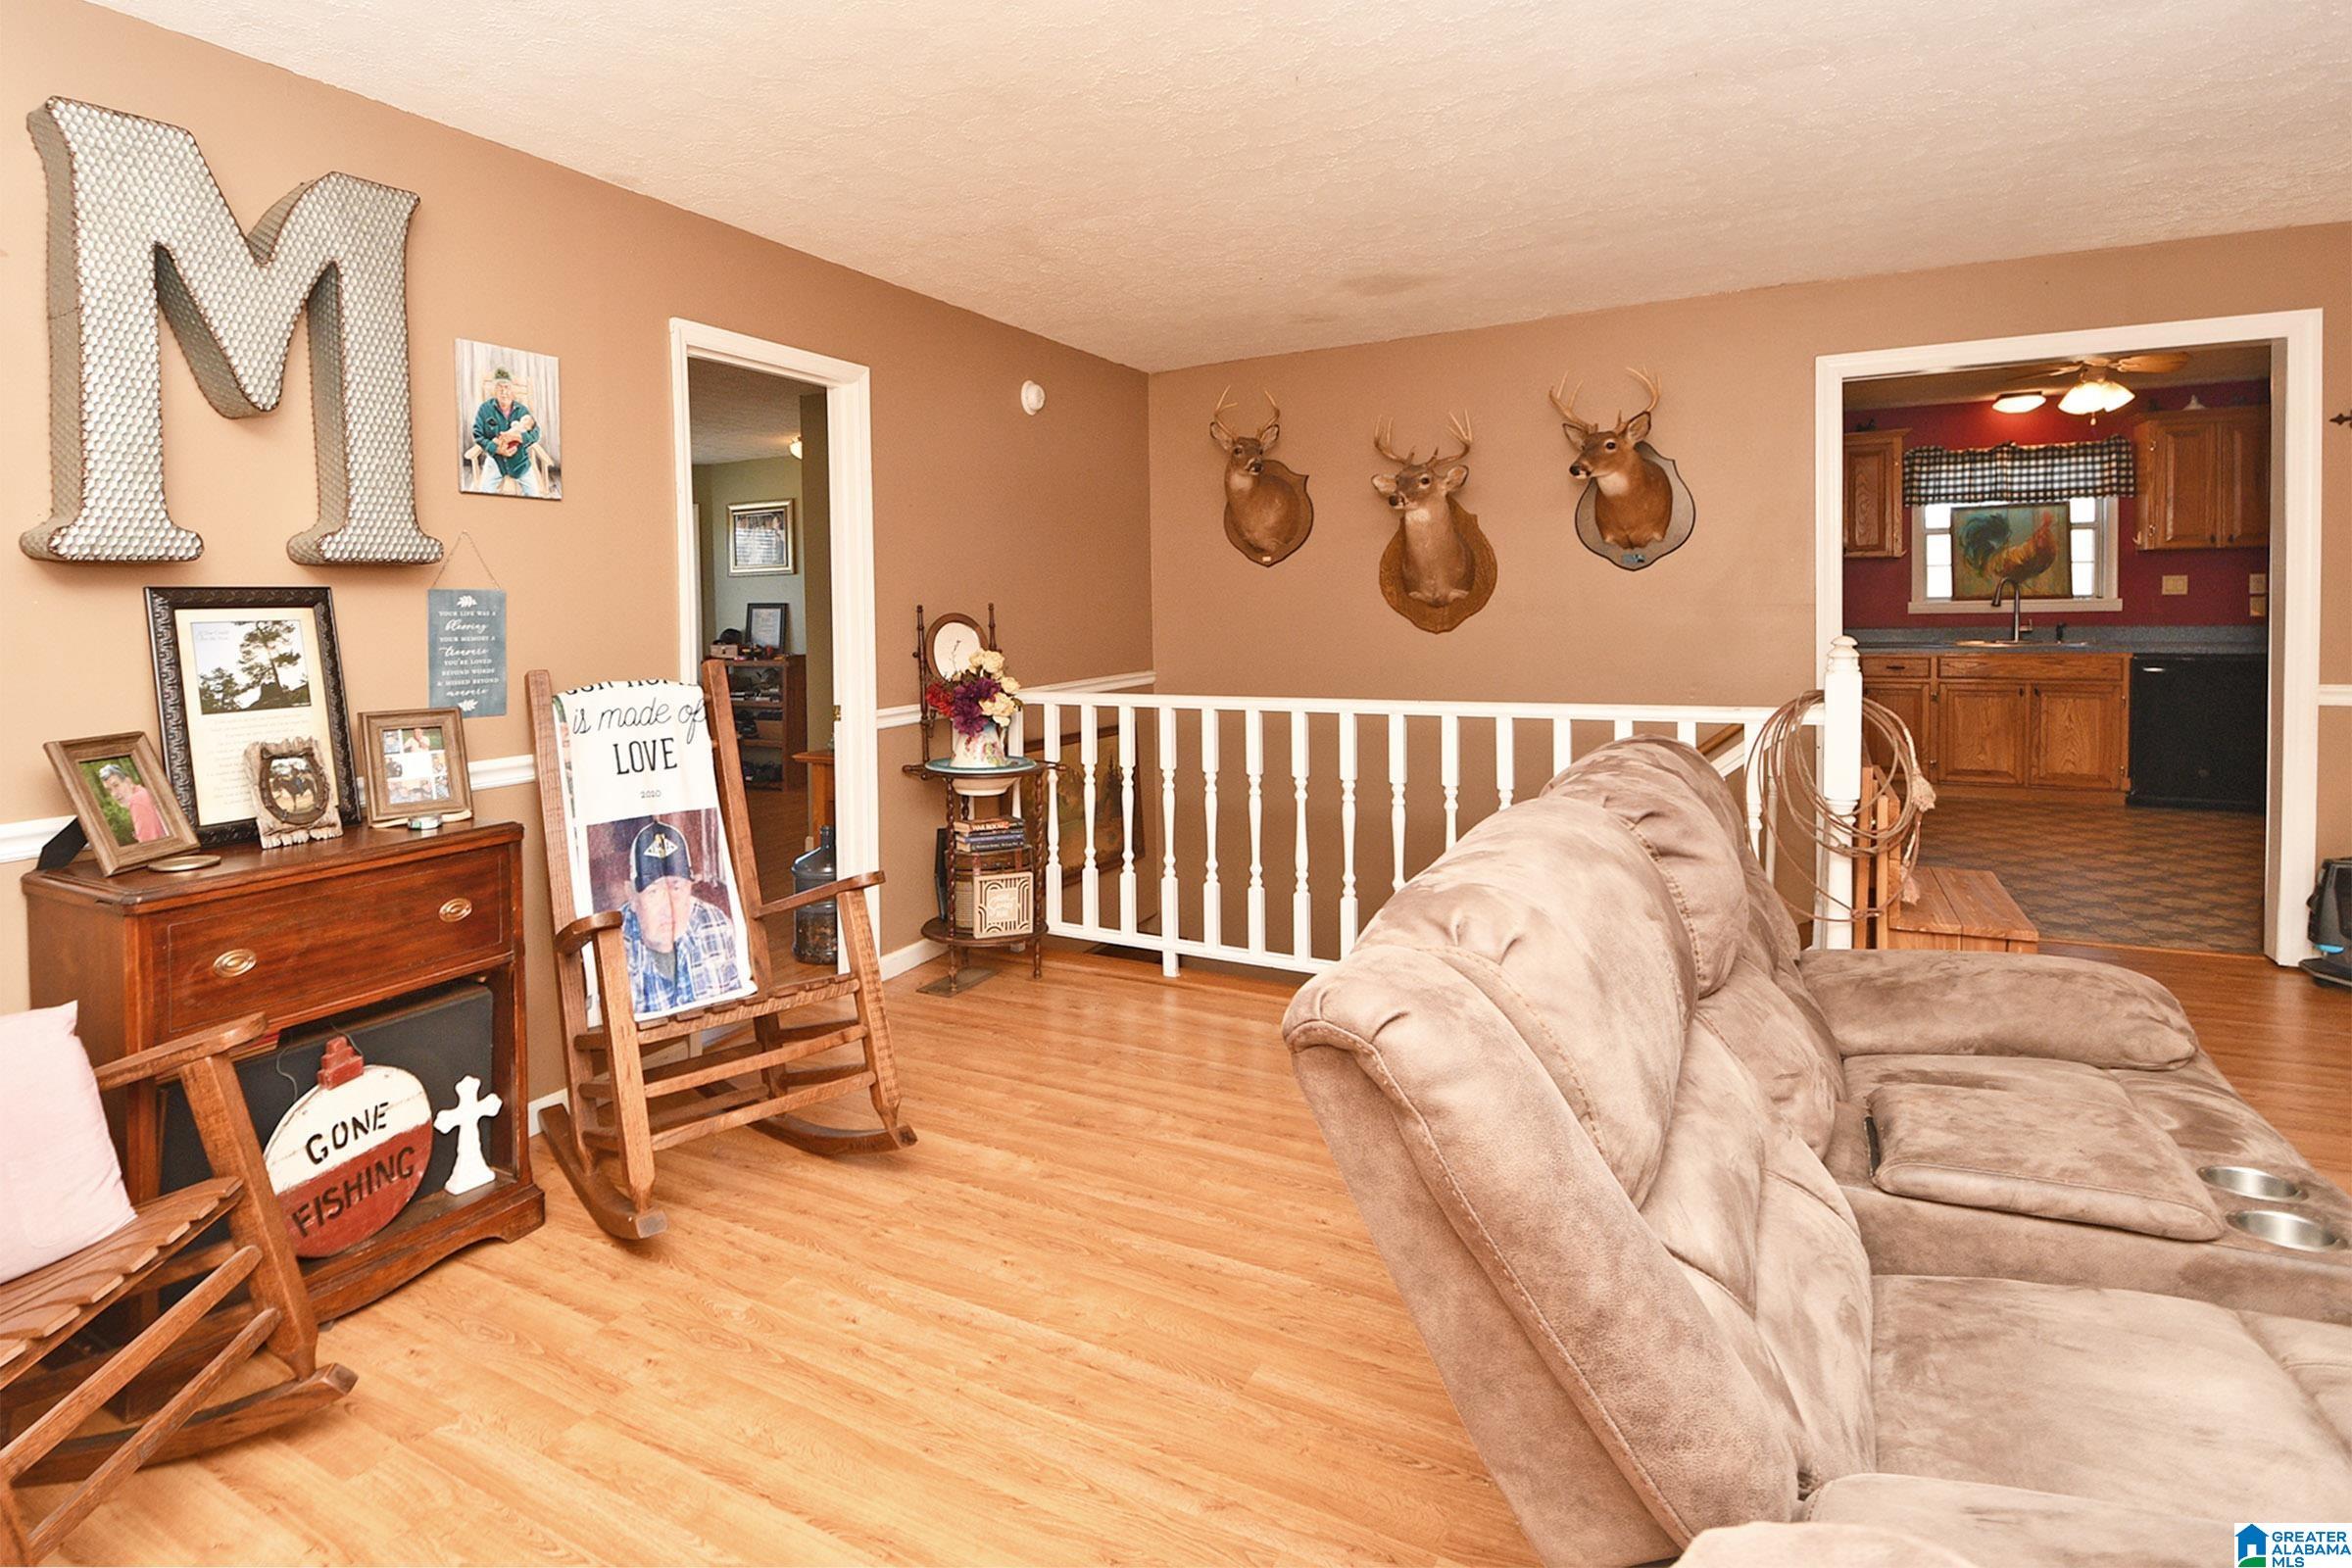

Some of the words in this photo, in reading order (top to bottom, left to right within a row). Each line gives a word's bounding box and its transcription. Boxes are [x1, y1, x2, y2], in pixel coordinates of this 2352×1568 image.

[22, 95, 445, 565] M
[572, 708, 591, 735] is
[598, 697, 672, 731] made
[678, 697, 707, 745] of
[612, 738, 678, 775] LOVE
[305, 1102, 389, 1165] GONE
[291, 1146, 416, 1238] FISHING
